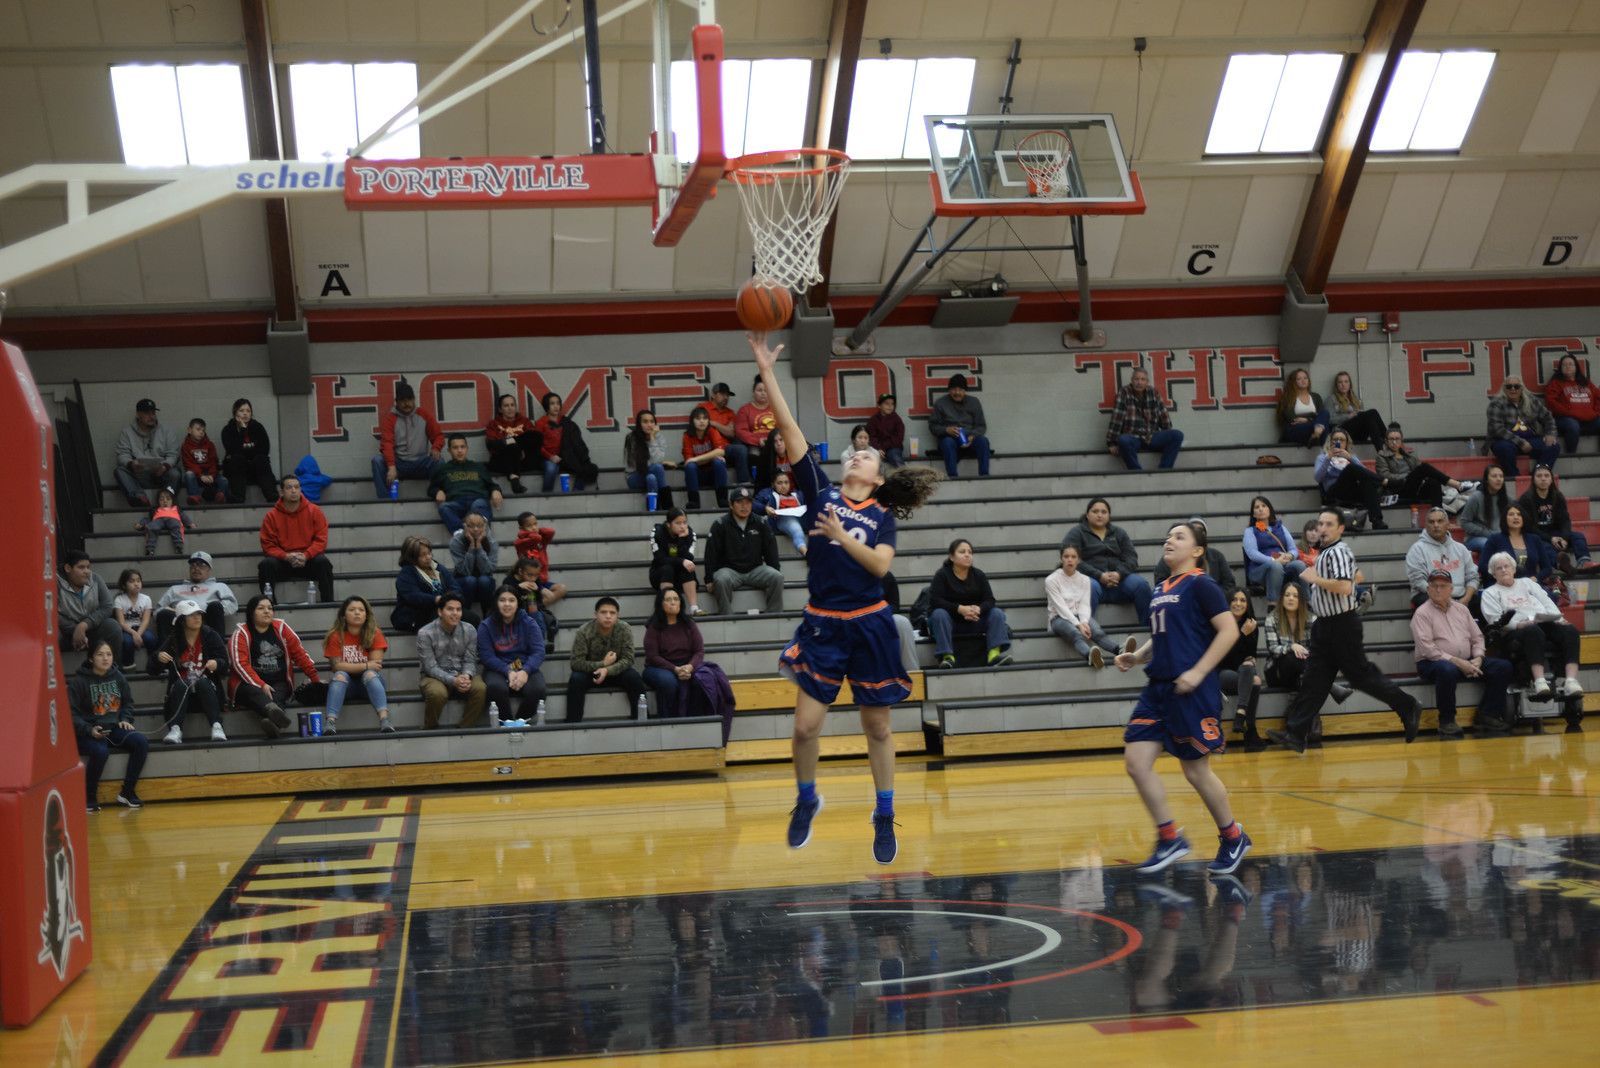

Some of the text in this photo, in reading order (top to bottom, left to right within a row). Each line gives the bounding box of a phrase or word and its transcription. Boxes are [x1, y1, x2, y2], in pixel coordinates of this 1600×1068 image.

[352, 163, 589, 198] PORTERVILLE
[1187, 249, 1216, 276] C
[1542, 241, 1573, 266] D
[320, 269, 352, 297] A
[311, 336, 1600, 441] HOME OF THE FIG
[1149, 608, 1166, 635] 11
[1200, 717, 1220, 740] S
